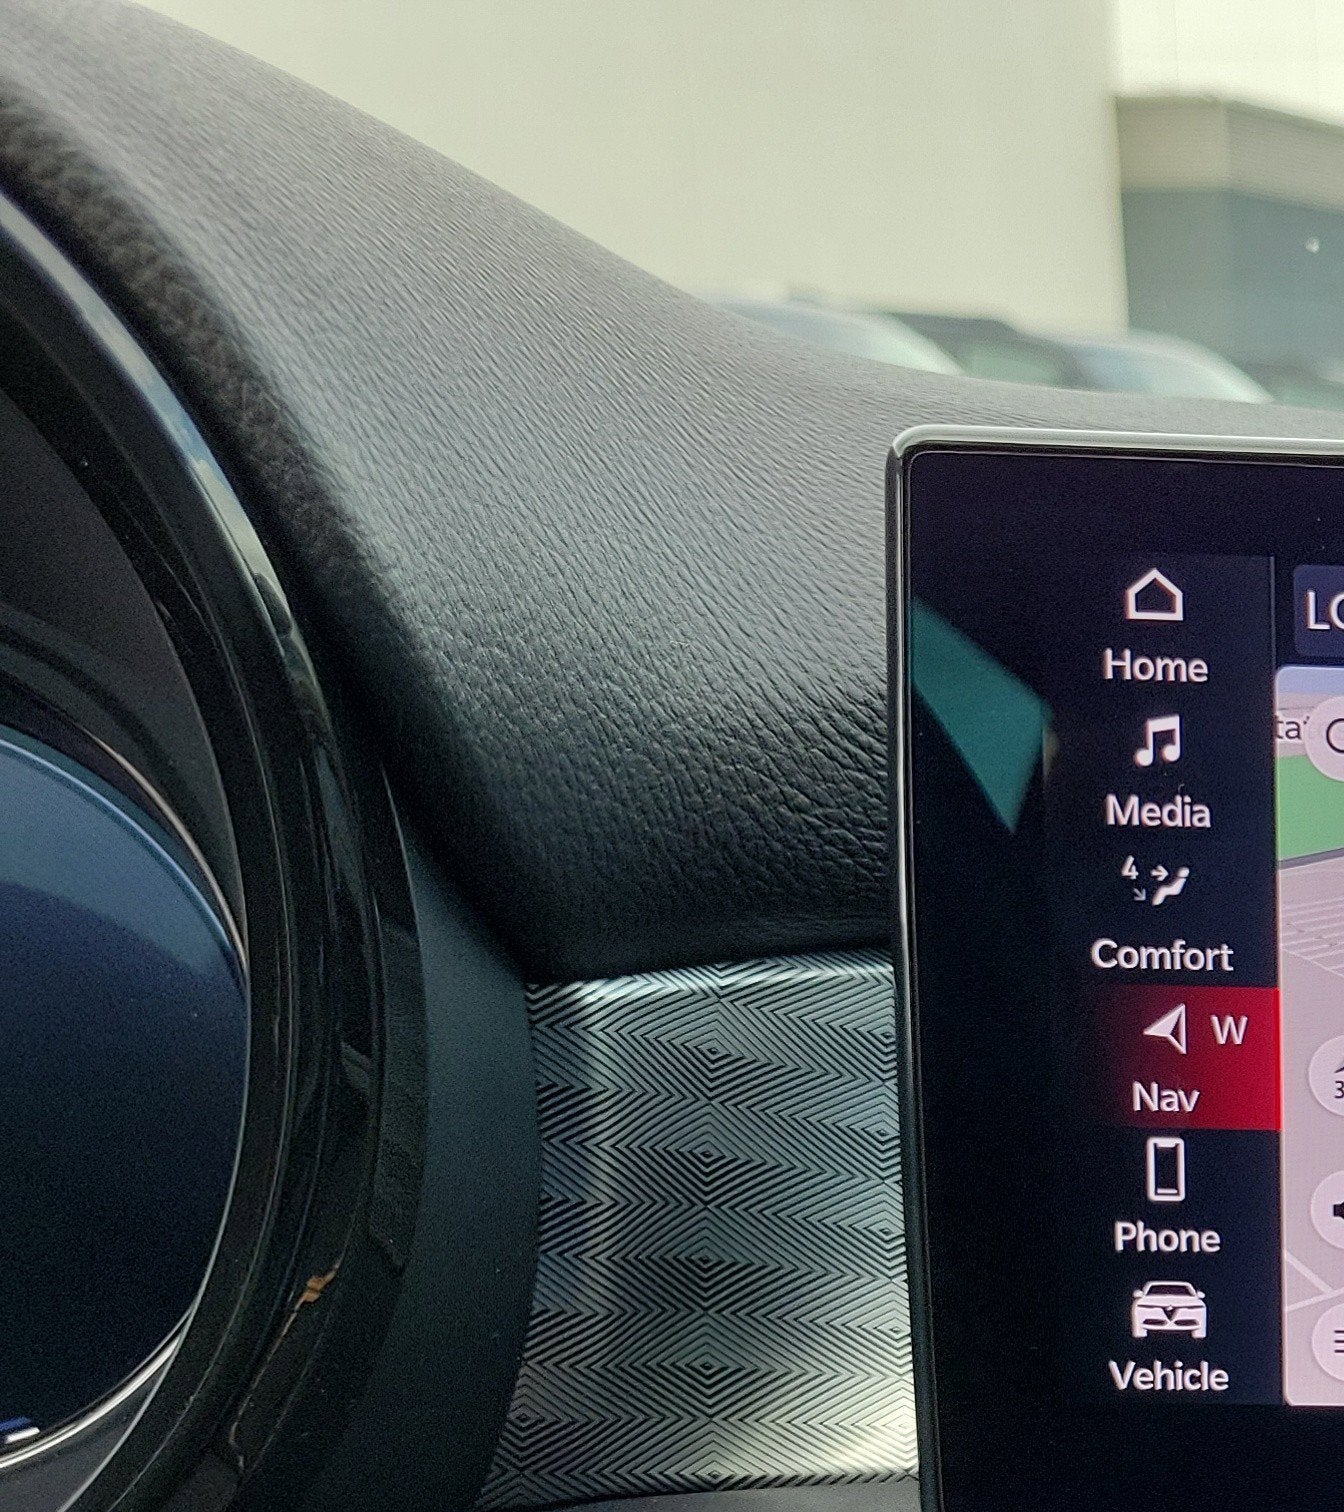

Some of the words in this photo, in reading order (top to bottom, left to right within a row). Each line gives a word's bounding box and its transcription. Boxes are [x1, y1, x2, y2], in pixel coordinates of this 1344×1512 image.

[1103, 649, 1209, 684] Home
[1105, 795, 1212, 828] Media
[1091, 938, 1234, 971] Comfort
[1210, 1015, 1249, 1045] W
[1132, 1082, 1200, 1113] Nav
[1113, 1221, 1221, 1253] Phone
[1108, 1360, 1230, 1392] Vehicle
